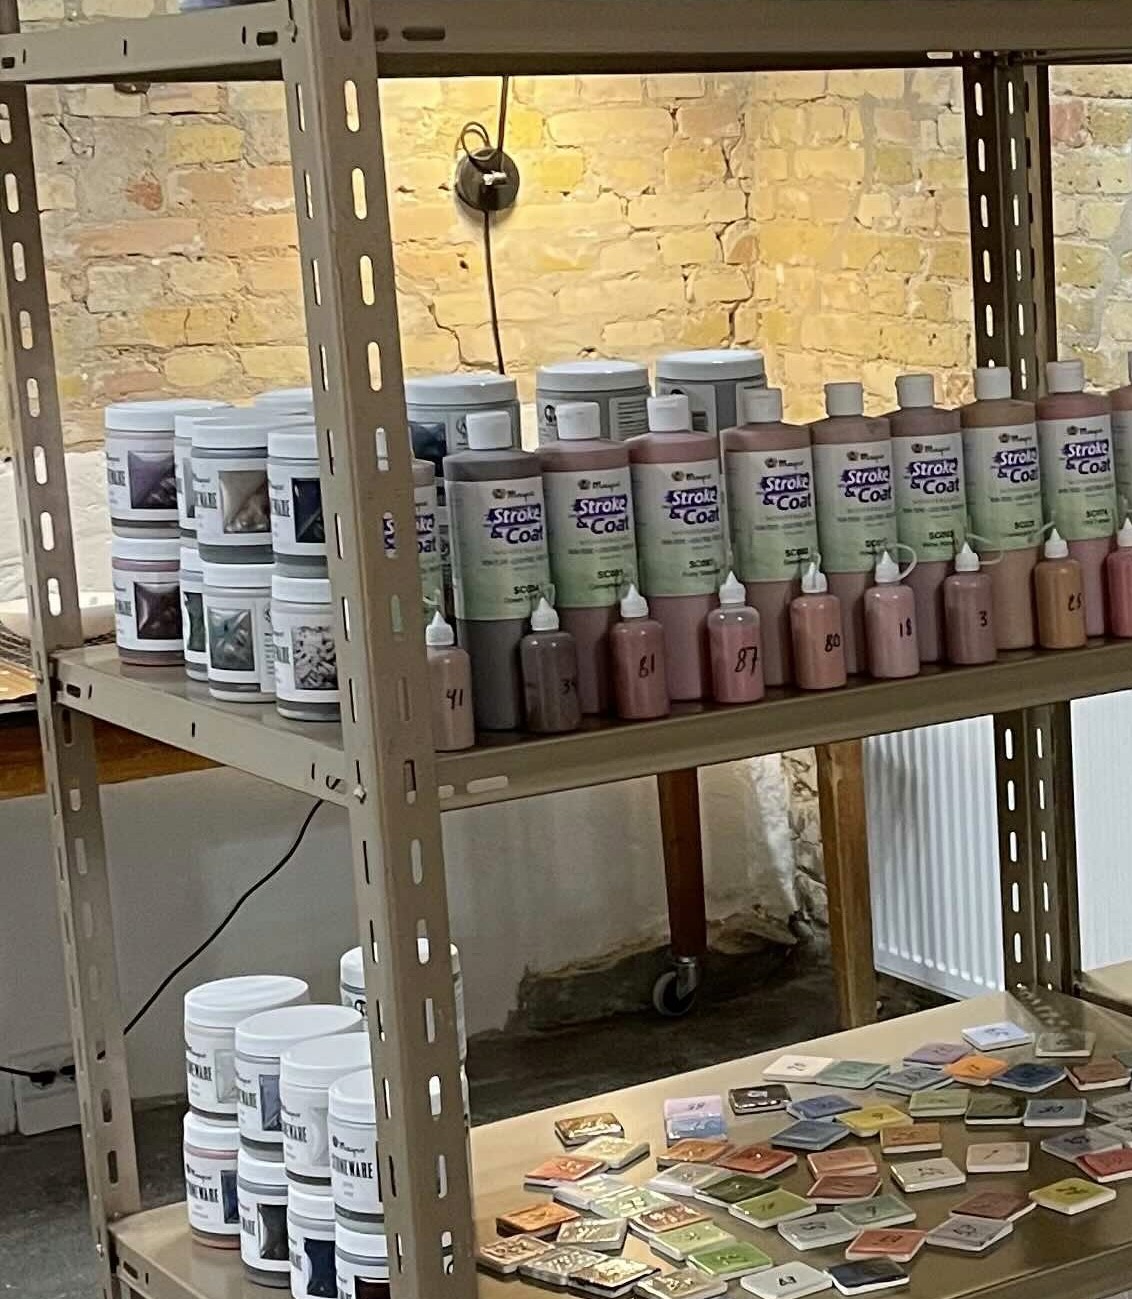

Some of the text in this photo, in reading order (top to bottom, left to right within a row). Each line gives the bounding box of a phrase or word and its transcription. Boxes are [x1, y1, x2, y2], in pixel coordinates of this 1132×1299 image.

[1068, 442, 1108, 457] Stroke
[912, 459, 957, 475] Stroke
[1078, 459, 1111, 474] Coat
[766, 474, 809, 491] Stroke
[848, 468, 890, 483] Stroke
[858, 487, 892, 502] Coat
[923, 479, 959, 494] Coat
[672, 487, 717, 504] Stroke
[777, 494, 811, 510] Coat
[579, 496, 627, 514] Stroke
[494, 505, 541, 523] Stroke
[683, 507, 719, 524] Coat
[591, 516, 629, 534] Coat
[506, 526, 543, 543] Coat
[825, 633, 840, 651] 80
[734, 646, 758, 674] 87
[447, 689, 463, 709] 41
